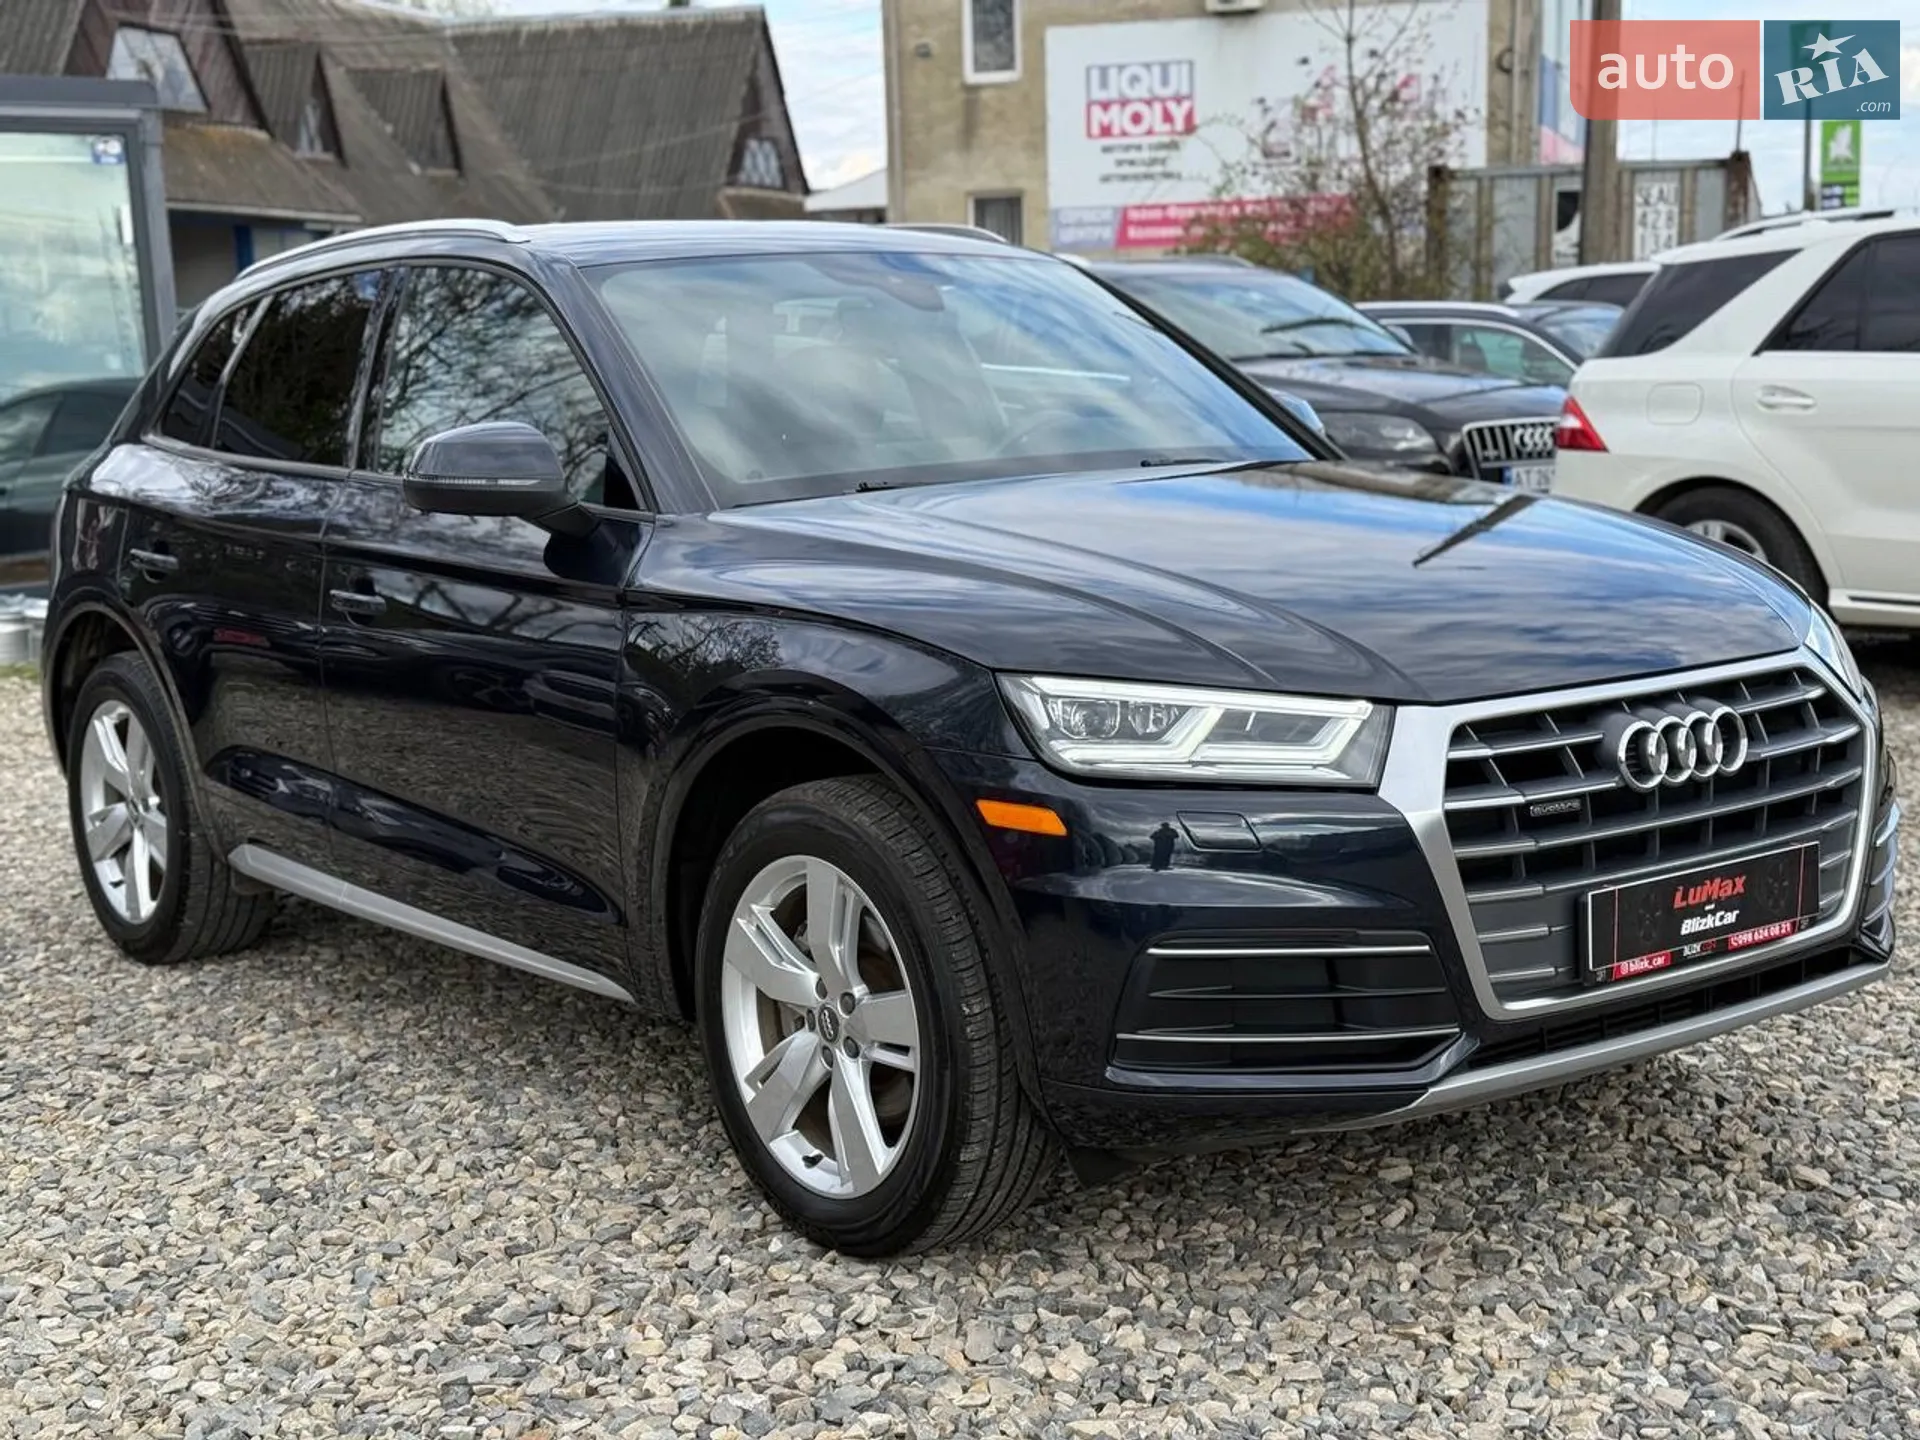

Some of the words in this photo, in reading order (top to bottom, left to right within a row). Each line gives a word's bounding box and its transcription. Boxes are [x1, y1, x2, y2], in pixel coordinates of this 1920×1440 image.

[1089, 63, 1190, 99] LIQUI
[1089, 101, 1193, 136] MOLY
[1674, 876, 1746, 909] LuMax
